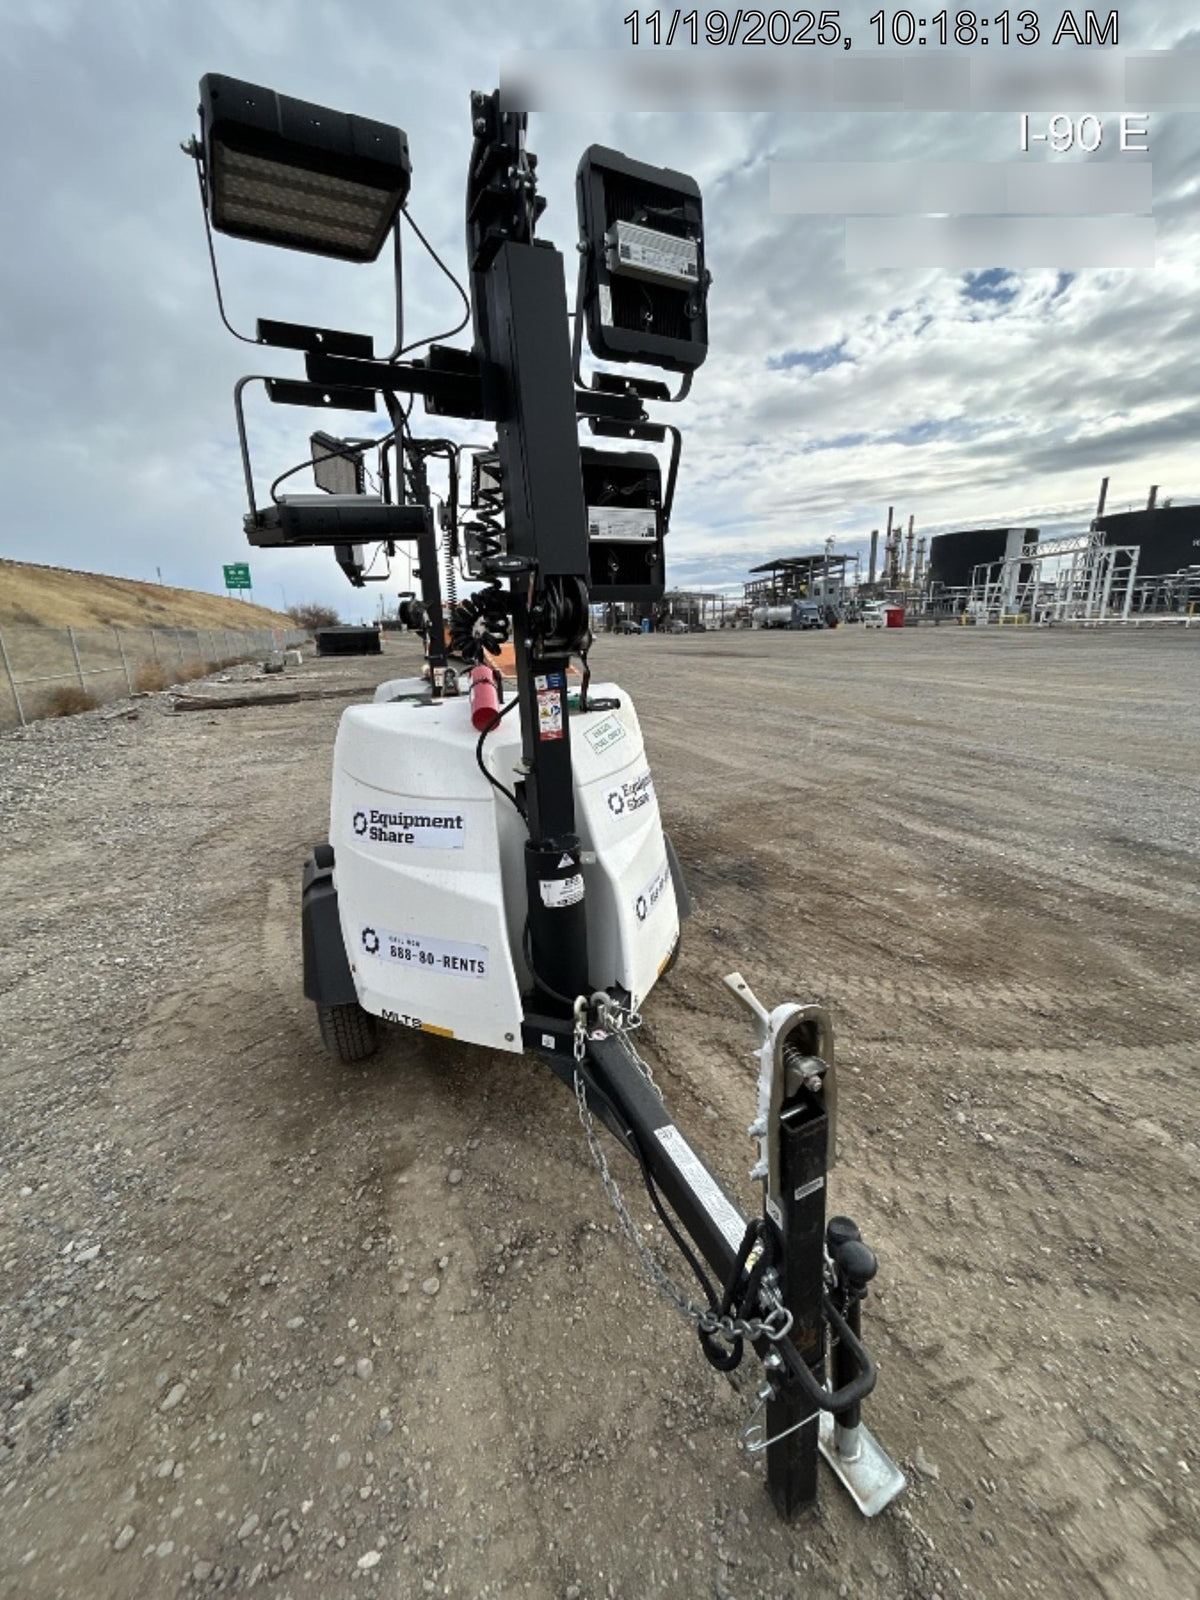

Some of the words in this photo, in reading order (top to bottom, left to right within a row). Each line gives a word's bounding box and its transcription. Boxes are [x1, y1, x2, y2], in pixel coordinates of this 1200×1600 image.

[369, 810, 464, 829] Equipment
[369, 826, 415, 844] Share
[389, 944, 485, 974] 888-80-RENTS
